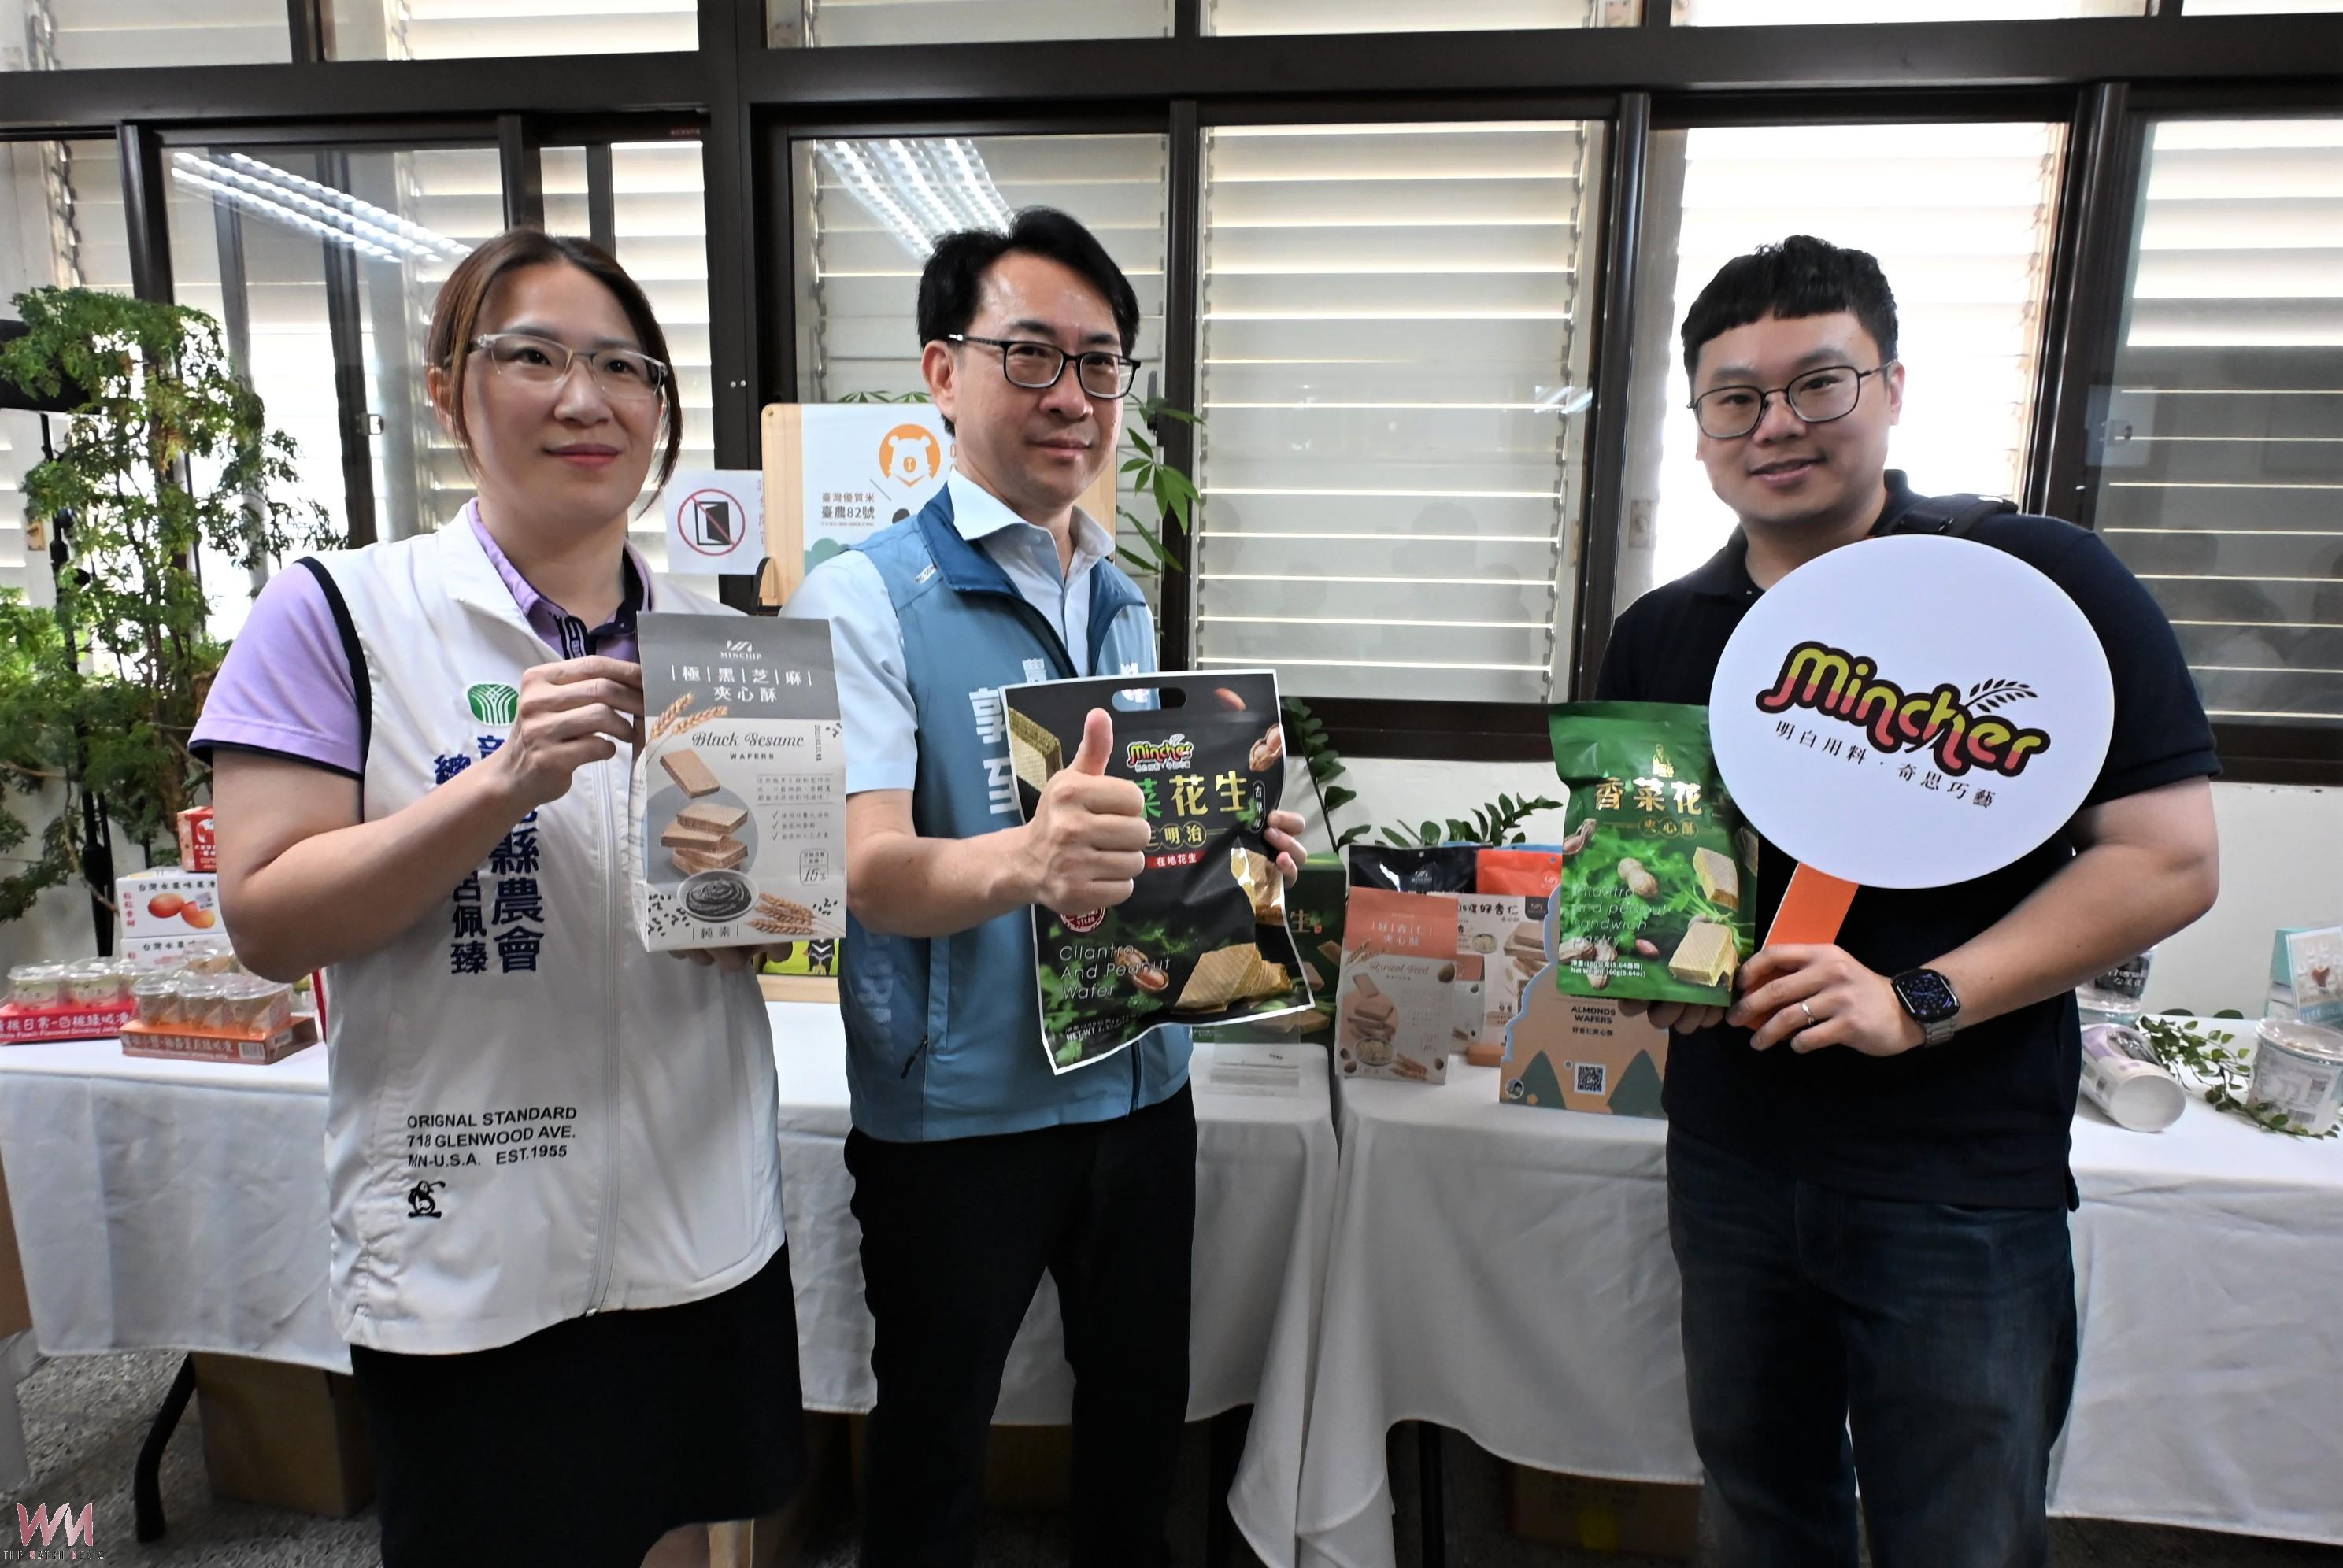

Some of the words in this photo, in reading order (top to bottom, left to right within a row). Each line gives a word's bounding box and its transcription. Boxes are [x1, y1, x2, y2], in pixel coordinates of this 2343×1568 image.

[720, 652, 761, 660] MINCHIP
[713, 686, 777, 703] 夾心酥
[691, 731, 740, 747] Black
[744, 733, 804, 747] Sesame
[1157, 853, 1197, 867] 在地花生
[487, 811, 544, 974] 縣農會
[1060, 943, 1134, 961] Cilantro
[1061, 964, 1097, 980] And
[1106, 956, 1171, 977] Peanut
[1064, 984, 1115, 1000] Wafer
[1571, 1005, 1616, 1016] ALMONDS
[1575, 1014, 1612, 1024] WAFERS
[407, 1114, 477, 1129] ORIGNAL
[483, 1107, 577, 1126] STANDARD
[406, 1134, 431, 1148] 718
[435, 1127, 534, 1148] GLENWOOD
[538, 1126, 576, 1139] AVE.
[408, 1154, 481, 1168] MN-U.S.A.
[496, 1145, 568, 1165] EST.1955
